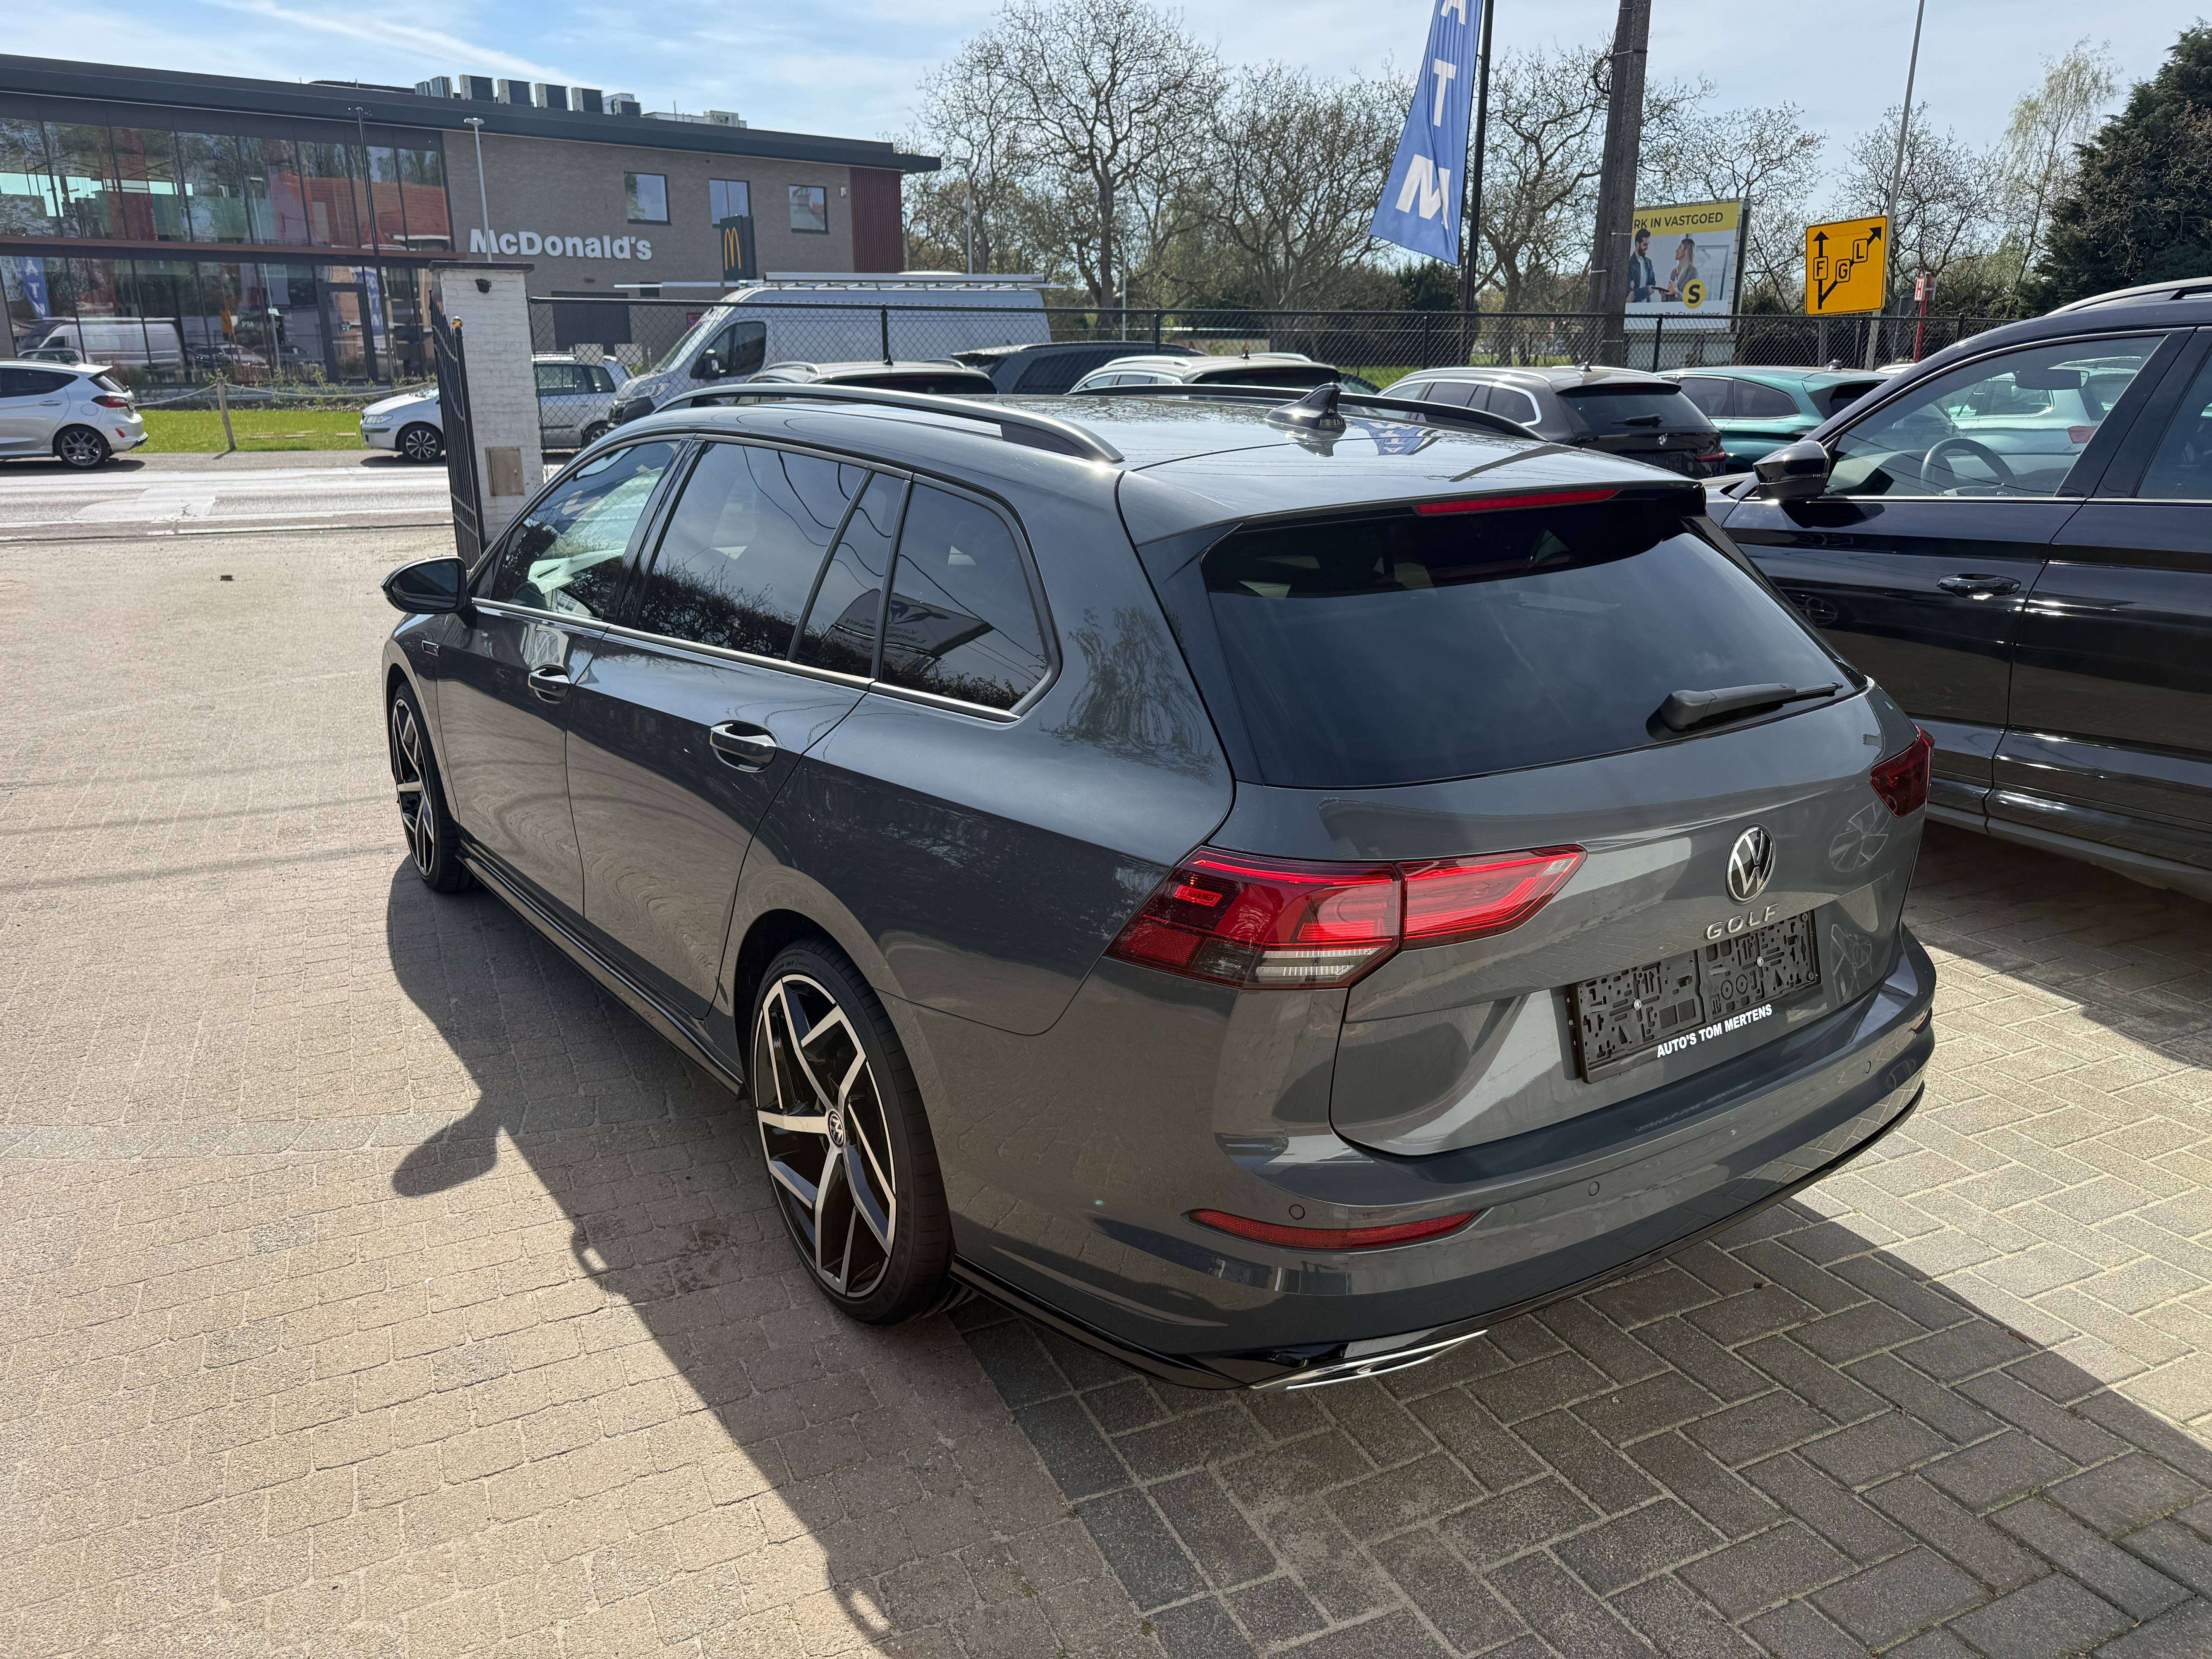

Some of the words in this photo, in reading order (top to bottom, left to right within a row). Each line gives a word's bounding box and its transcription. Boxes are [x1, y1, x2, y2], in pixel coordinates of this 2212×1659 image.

[1633, 218, 1647, 229] RK
[1650, 217, 1661, 228] IN
[1665, 212, 1723, 227] VASTGOED
[469, 228, 653, 261] McDonald's
[1856, 243, 1864, 259] L
[1817, 261, 1825, 276] F
[1839, 263, 1848, 279] G
[1688, 284, 1700, 303] S
[1705, 903, 1778, 940] GOLF
[1657, 1032, 1697, 1058] AUTO'S
[1698, 1022, 1723, 1041] TOM
[1724, 1004, 1772, 1032] MERTENS
